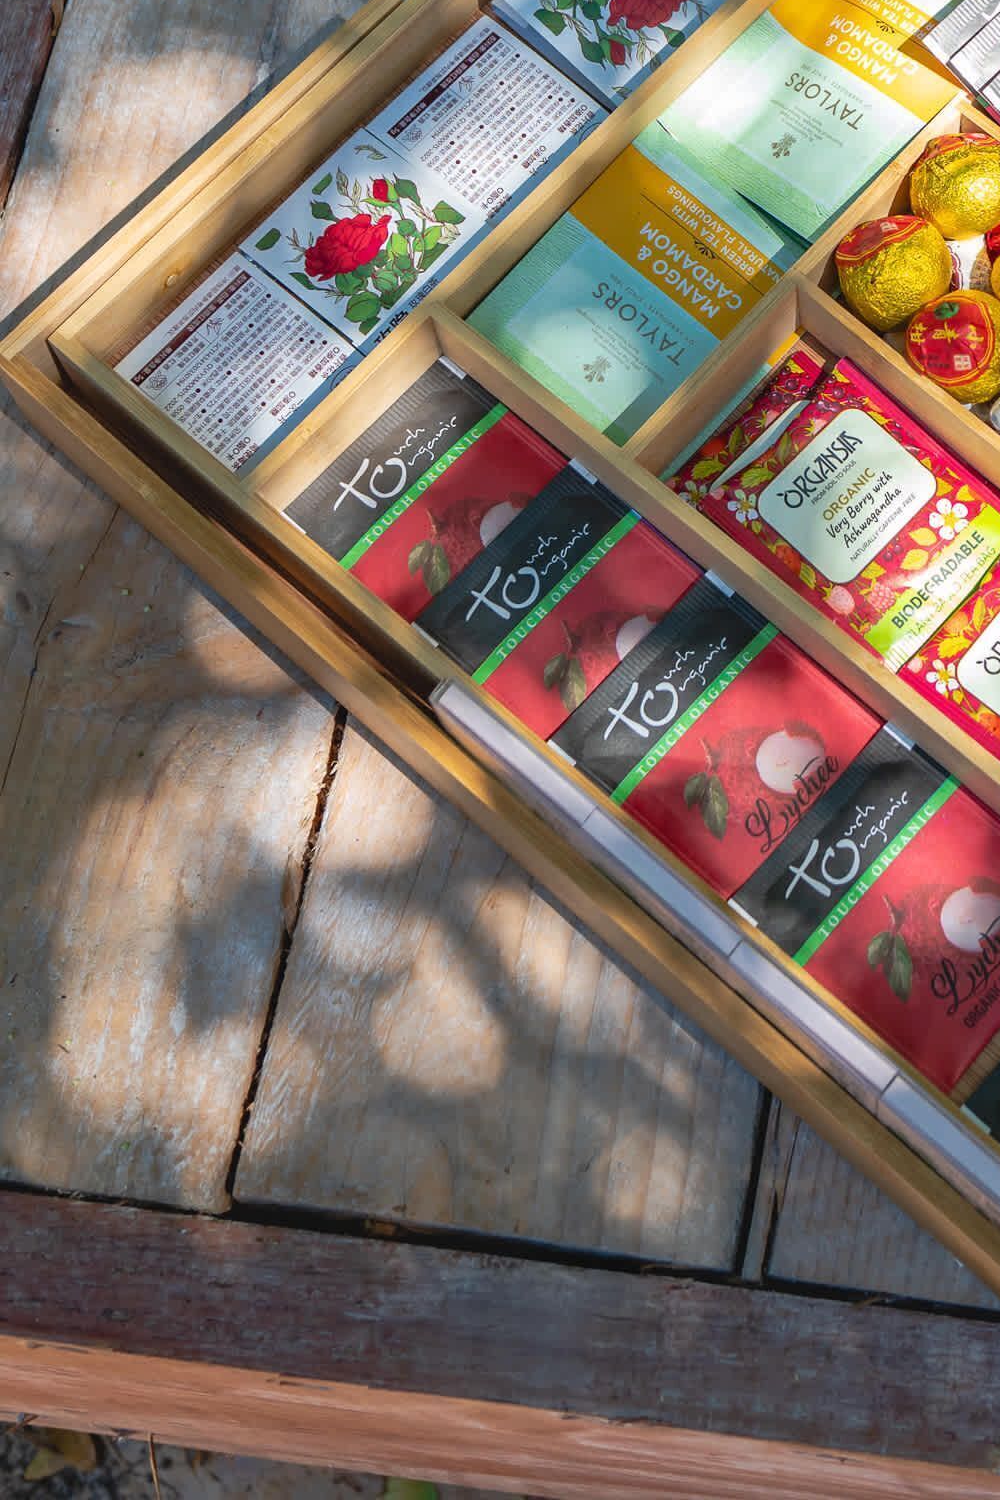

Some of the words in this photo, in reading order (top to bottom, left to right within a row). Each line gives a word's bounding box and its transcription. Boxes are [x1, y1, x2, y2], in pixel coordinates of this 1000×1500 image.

[823, 32, 837, 47] &
[829, 12, 919, 76] CARDAMOM
[880, 7, 899, 24] TEA
[835, 39, 897, 85] MANGO
[783, 69, 865, 131] TAYLORS
[666, 182, 736, 245] FLAVOURINGS
[670, 203, 699, 231] WITH
[698, 225, 721, 249] TEA
[634, 244, 652, 263] &
[638, 219, 745, 311] CARDAMOM
[718, 243, 756, 278] GREEN
[650, 256, 720, 319] MANGO
[590, 278, 688, 366] TAYLORS
[362, 494, 414, 546] TOUCH
[416, 427, 483, 491] ORGANIC
[809, 487, 827, 505] FROM
[823, 476, 838, 491] SOIL
[834, 470, 844, 480] TO
[820, 466, 876, 521] ORGANIC
[826, 514, 852, 538] Very
[845, 490, 874, 518] Berry
[870, 469, 893, 493] with
[845, 486, 902, 549] Ashwagandha
[848, 529, 881, 563] NATURALLY
[495, 605, 548, 659] TOUCH
[550, 536, 616, 602] ORGANIC
[890, 529, 985, 629] BIODEGRADABLE
[635, 722, 687, 776] TOUCH
[688, 650, 754, 720] ORGANIC
[747, 753, 838, 853] Lychee
[818, 880, 870, 937] TOUCH
[871, 804, 937, 877] ORGANIC
